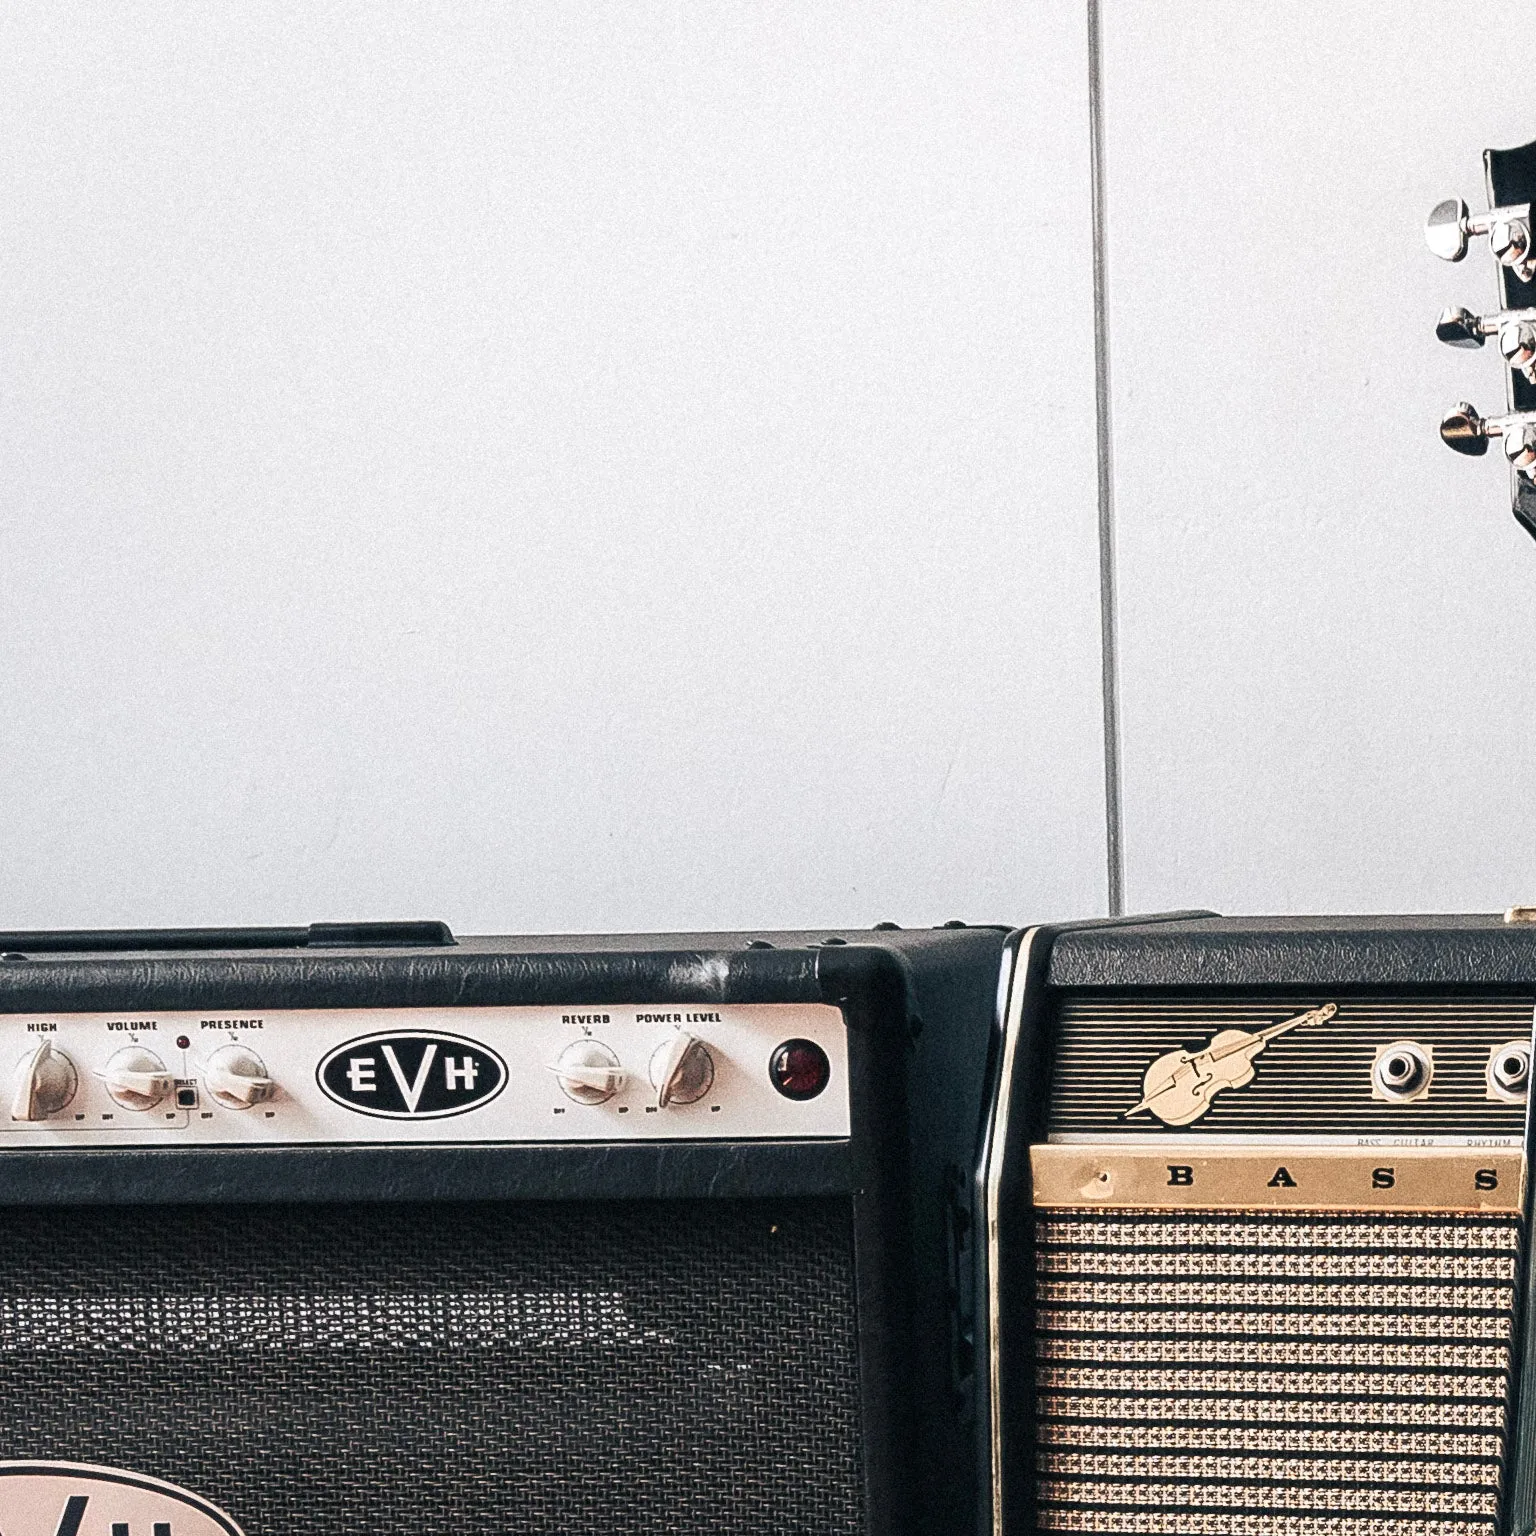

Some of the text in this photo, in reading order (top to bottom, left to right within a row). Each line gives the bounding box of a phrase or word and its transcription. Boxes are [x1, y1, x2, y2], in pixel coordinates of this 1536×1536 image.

[562, 1014, 610, 1024] REVERB
[636, 1012, 722, 1023] POWER LEVEL
[27, 1023, 57, 1032] HIGH
[107, 1021, 158, 1030] VOLUME
[200, 1019, 263, 1029] PRESENCE
[347, 1044, 479, 1113] EVH
